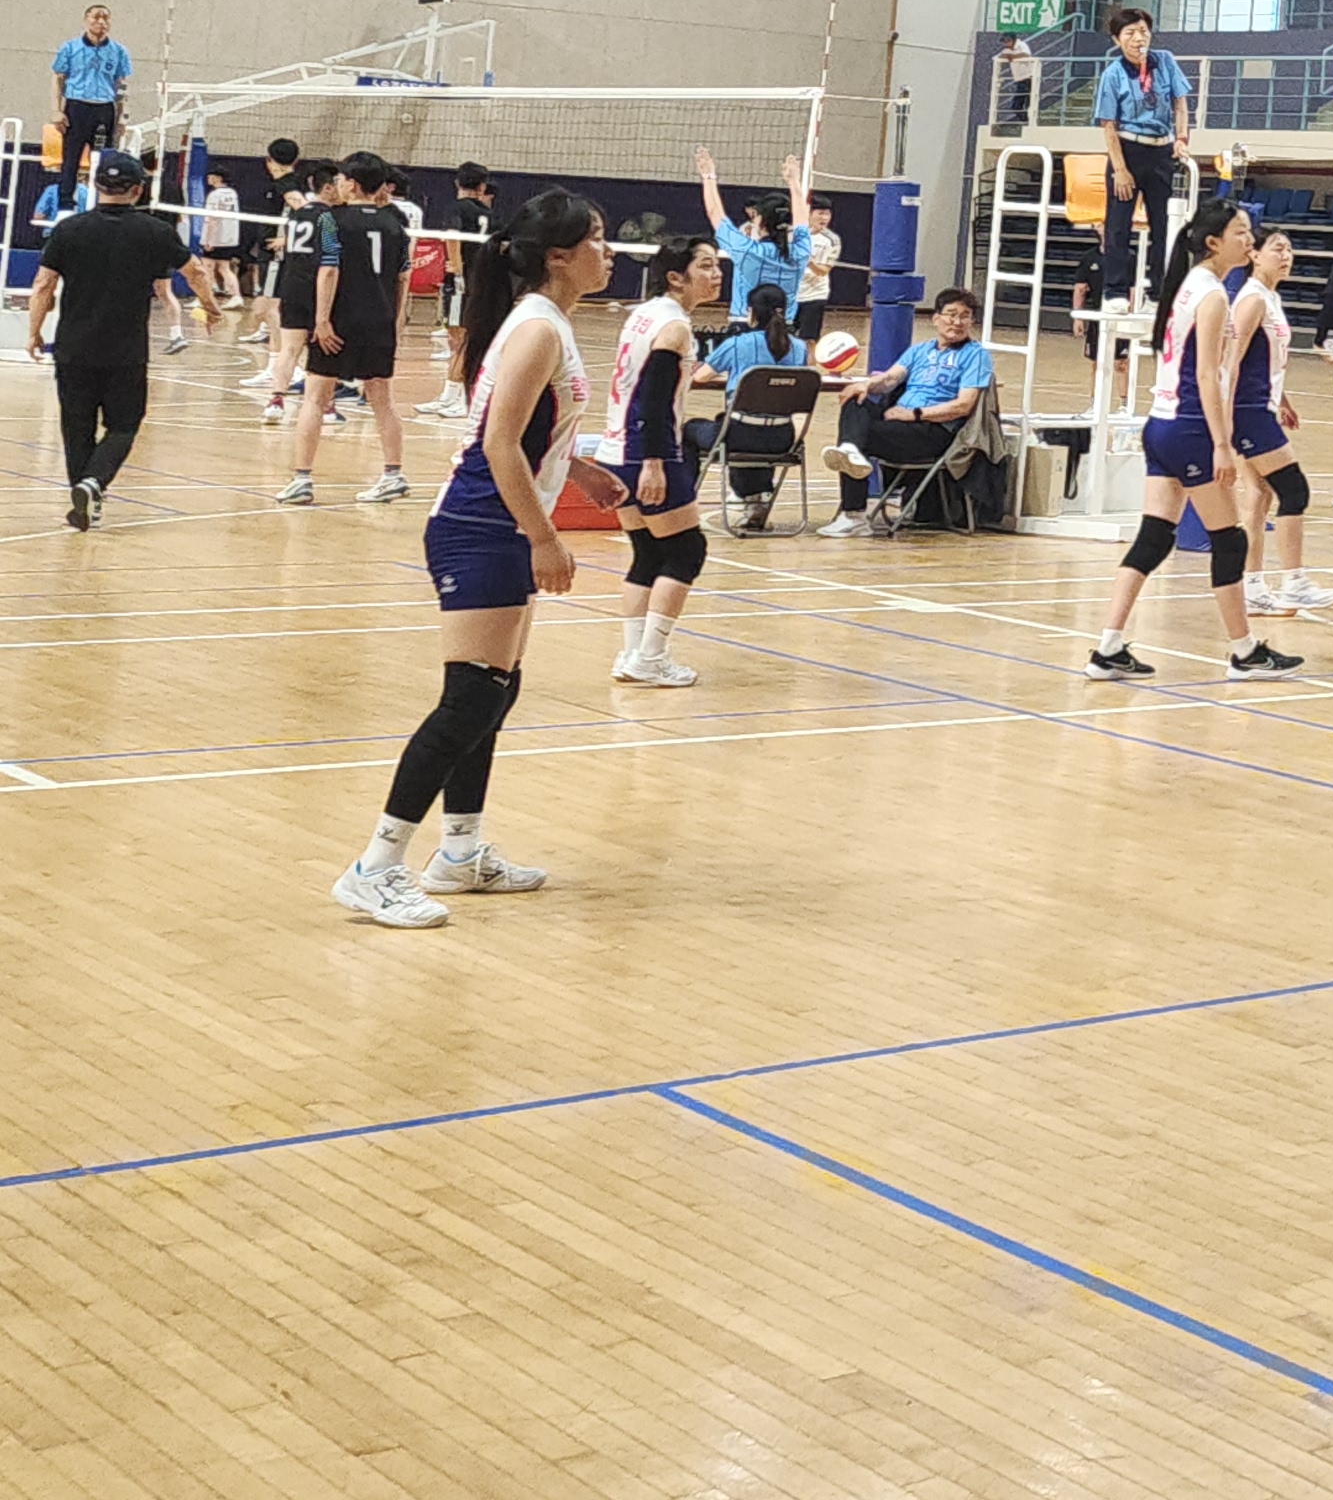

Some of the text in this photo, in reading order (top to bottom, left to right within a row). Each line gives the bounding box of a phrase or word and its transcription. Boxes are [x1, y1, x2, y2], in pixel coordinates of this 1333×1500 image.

[1000, 1, 1036, 24] EXIT
[287, 218, 315, 253] 12
[366, 230, 382, 274] 1
